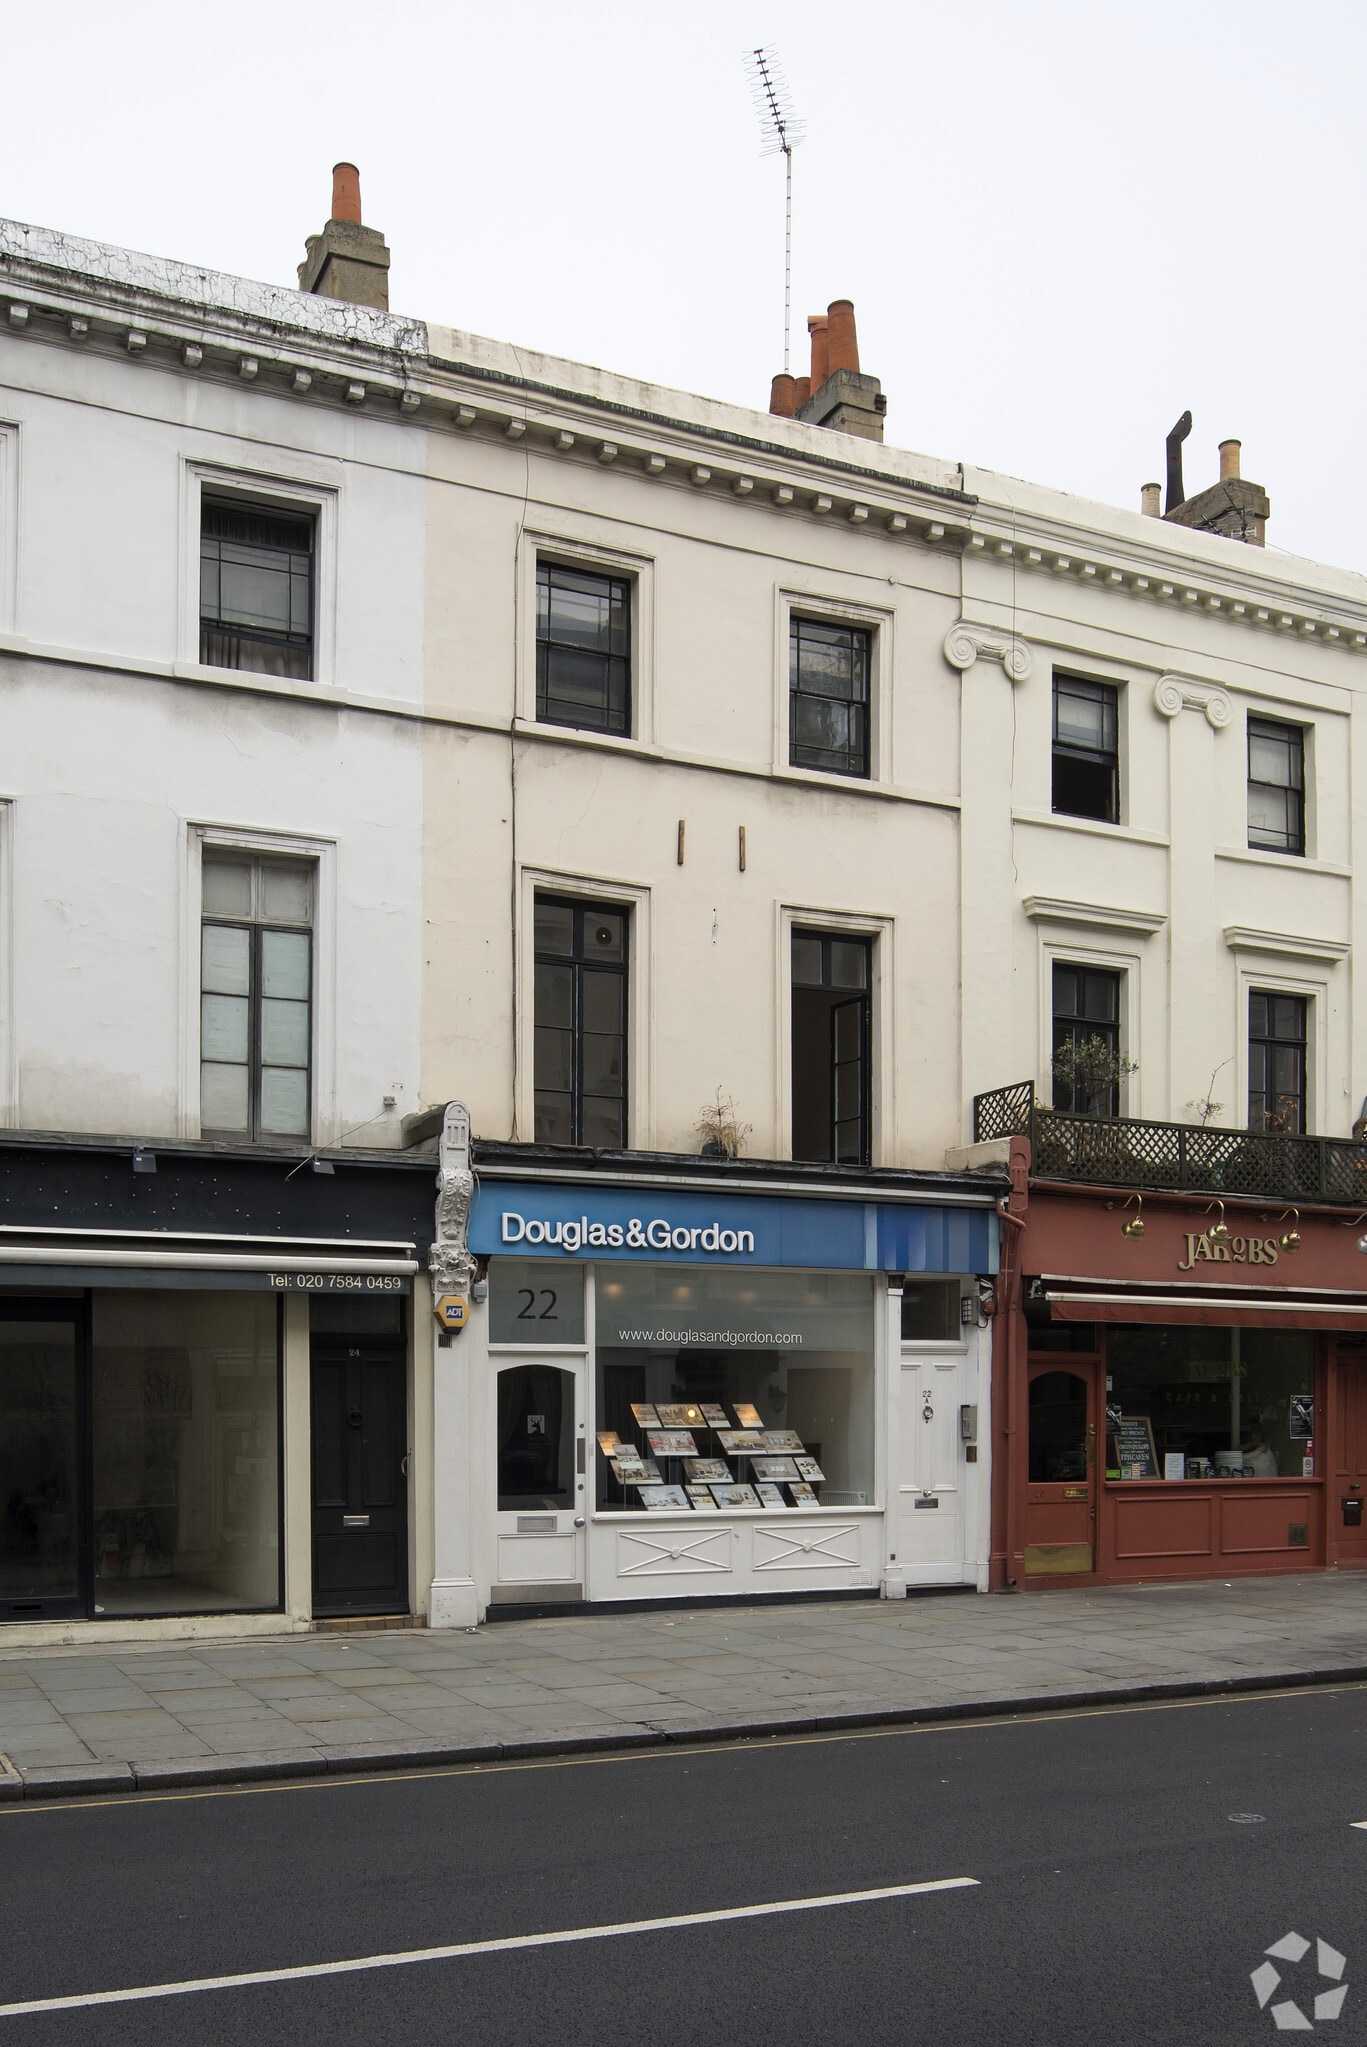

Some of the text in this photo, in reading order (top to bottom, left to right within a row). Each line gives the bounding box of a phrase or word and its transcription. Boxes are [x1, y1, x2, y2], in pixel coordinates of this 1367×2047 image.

[501, 1212, 755, 1252] Douglas&Gordon
[267, 1273, 401, 1289] Tel: 020 7584 0459
[446, 1307, 463, 1317] ADT
[517, 1288, 558, 1320] 22
[619, 1328, 802, 1345] www.douglasandgordon.com
[1182, 1360, 1248, 1378] JAOBS
[922, 1390, 932, 1398] 22
